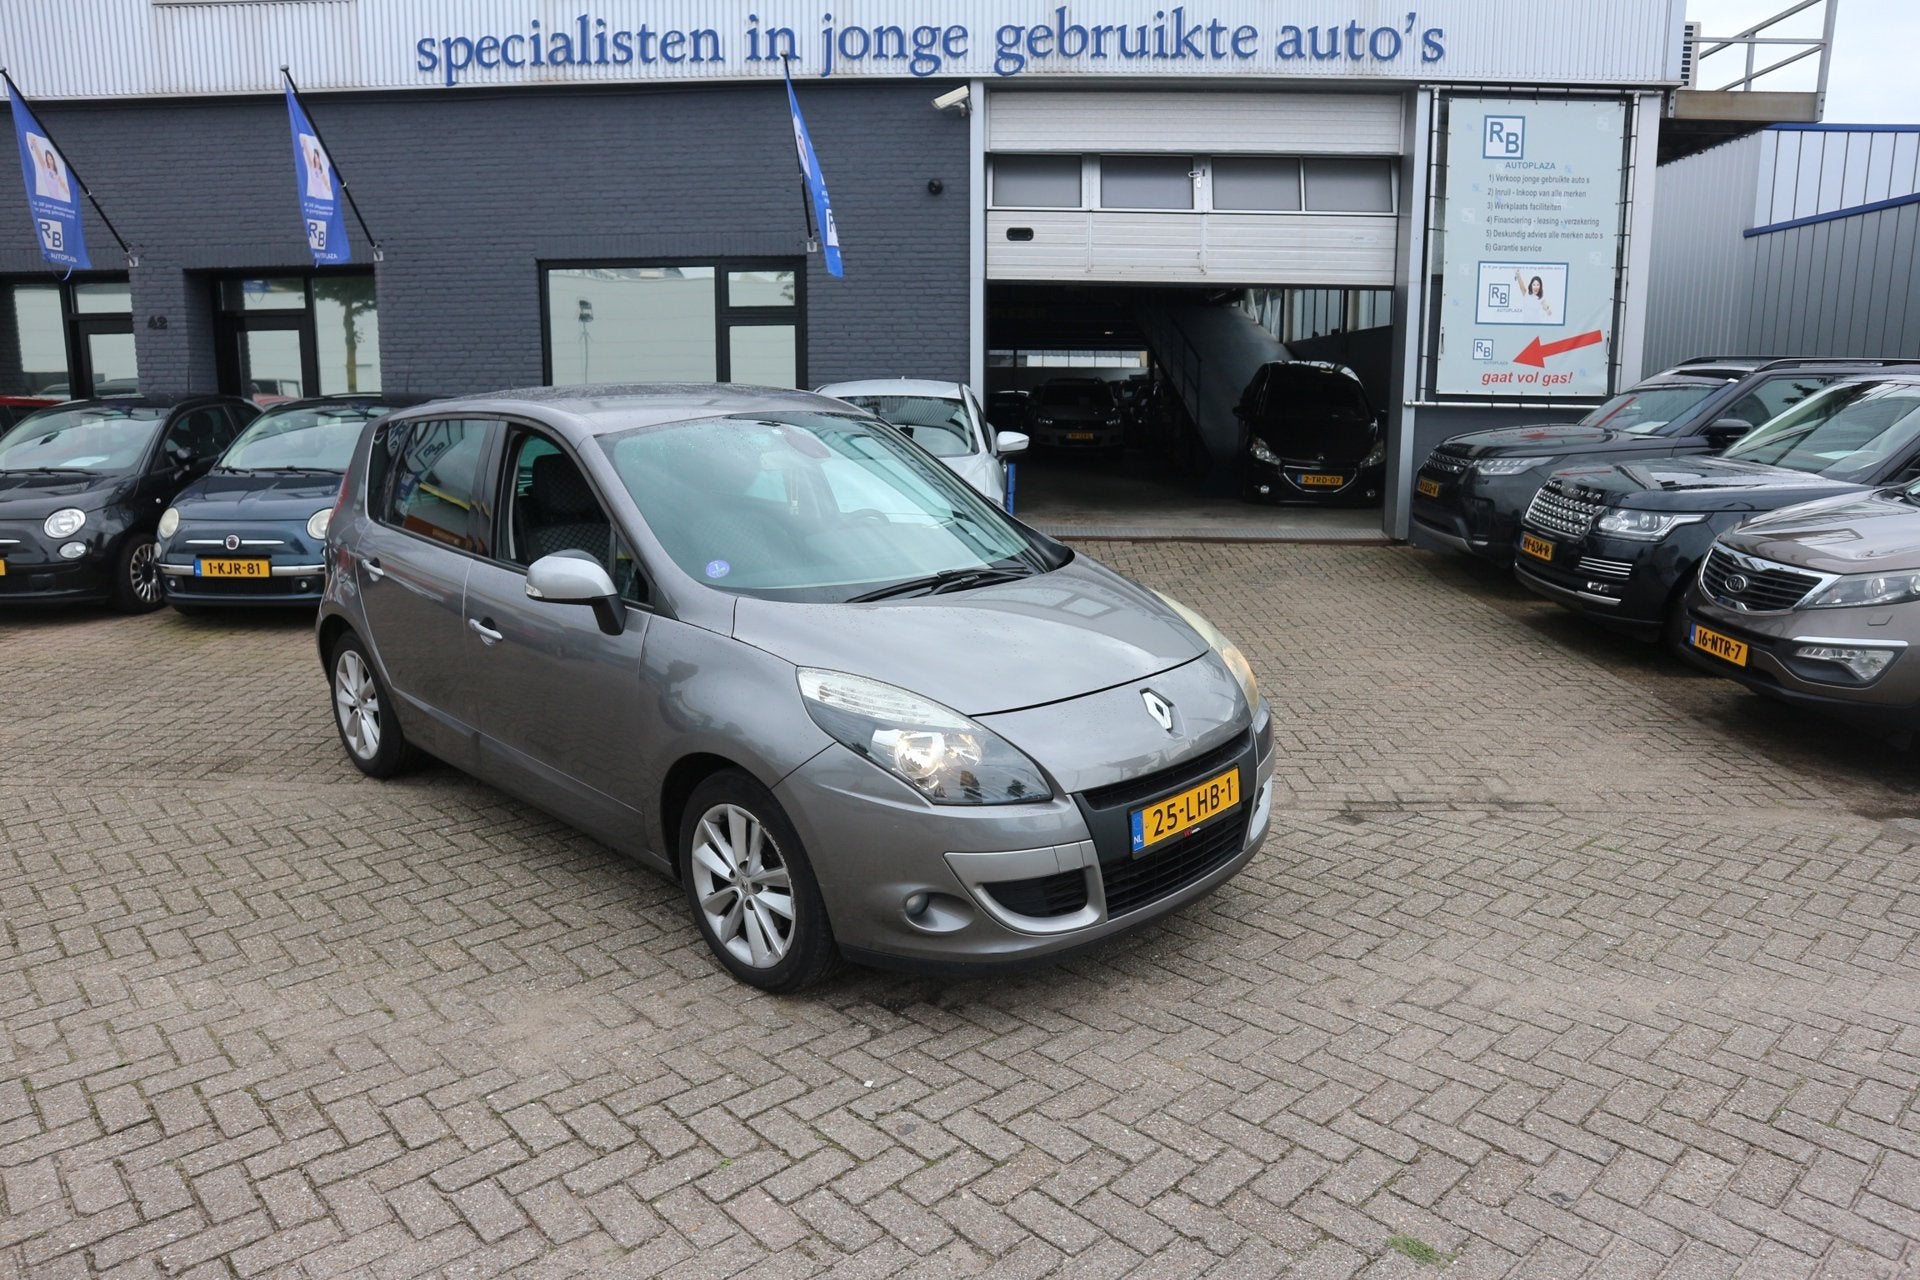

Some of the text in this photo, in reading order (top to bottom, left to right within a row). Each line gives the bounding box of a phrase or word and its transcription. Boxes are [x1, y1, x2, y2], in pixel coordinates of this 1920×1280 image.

[417, 6, 1444, 87] specialisten in jonge gebruikte auto's
[1489, 121, 1520, 154] RB
[1505, 161, 1556, 170] AUTOPLAZA
[1496, 174, 1521, 184] Verkoop
[1521, 175, 1540, 185] jonge
[1541, 175, 1570, 185] gebruikte
[1516, 188, 1538, 198] Inkoop
[1551, 189, 1562, 197] alle
[1563, 189, 1587, 198] merken
[1494, 201, 1528, 211] Werkplaats
[1494, 215, 1532, 226] Financiering
[1537, 216, 1559, 227] leasing
[1564, 217, 1600, 228] verzekering
[1493, 229, 1526, 240] Deskundig
[1527, 230, 1548, 239] advies
[1549, 231, 1560, 239] alle
[1493, 243, 1518, 251] Garantie
[1520, 244, 1542, 252] service
[1481, 371, 1574, 387] gaat vol gas!
[208, 562, 260, 575] 1-KJR-81
[1698, 629, 1743, 660] 16-NTR-7
[1153, 777, 1231, 837] 25-LHB-1
[1133, 834, 1144, 846] NL
